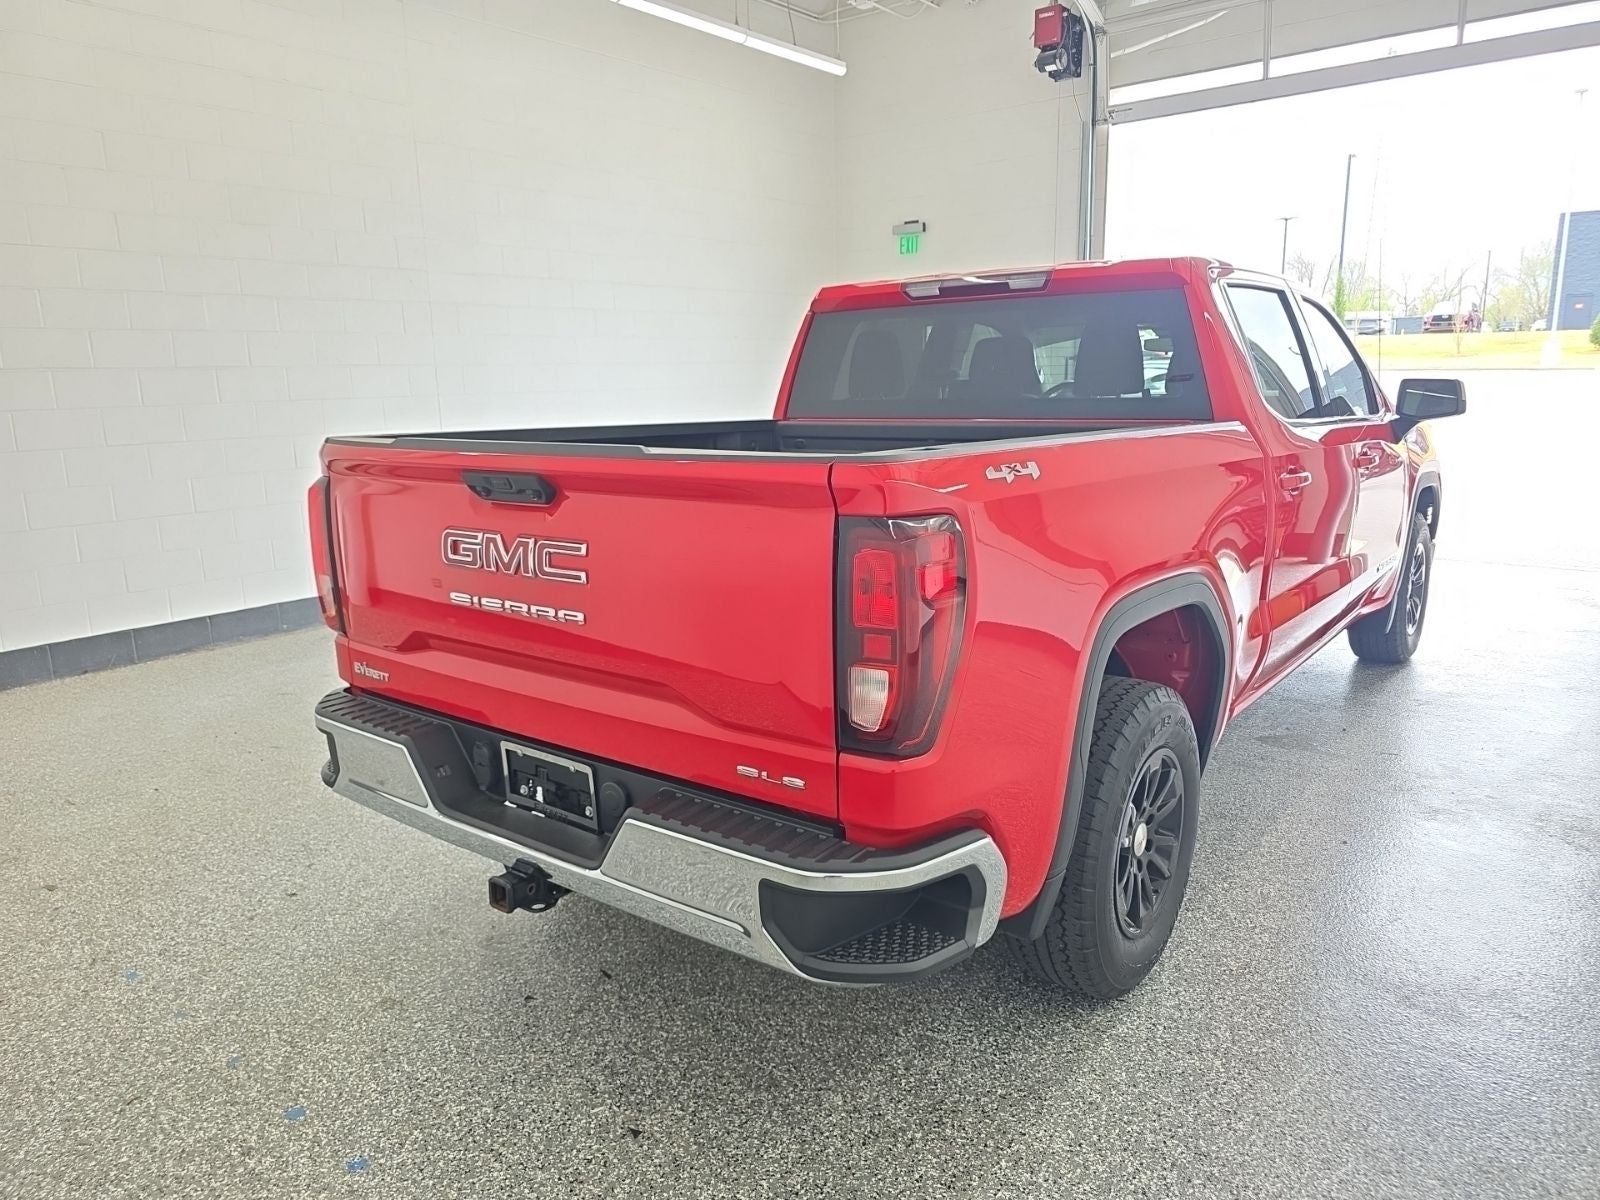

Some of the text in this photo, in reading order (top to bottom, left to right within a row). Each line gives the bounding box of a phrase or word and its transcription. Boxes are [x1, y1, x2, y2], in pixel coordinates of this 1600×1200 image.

[900, 234, 920, 255] EXIT
[442, 527, 588, 585] GMC
[450, 591, 585, 625] SIERRA
[736, 765, 806, 789] SLE
